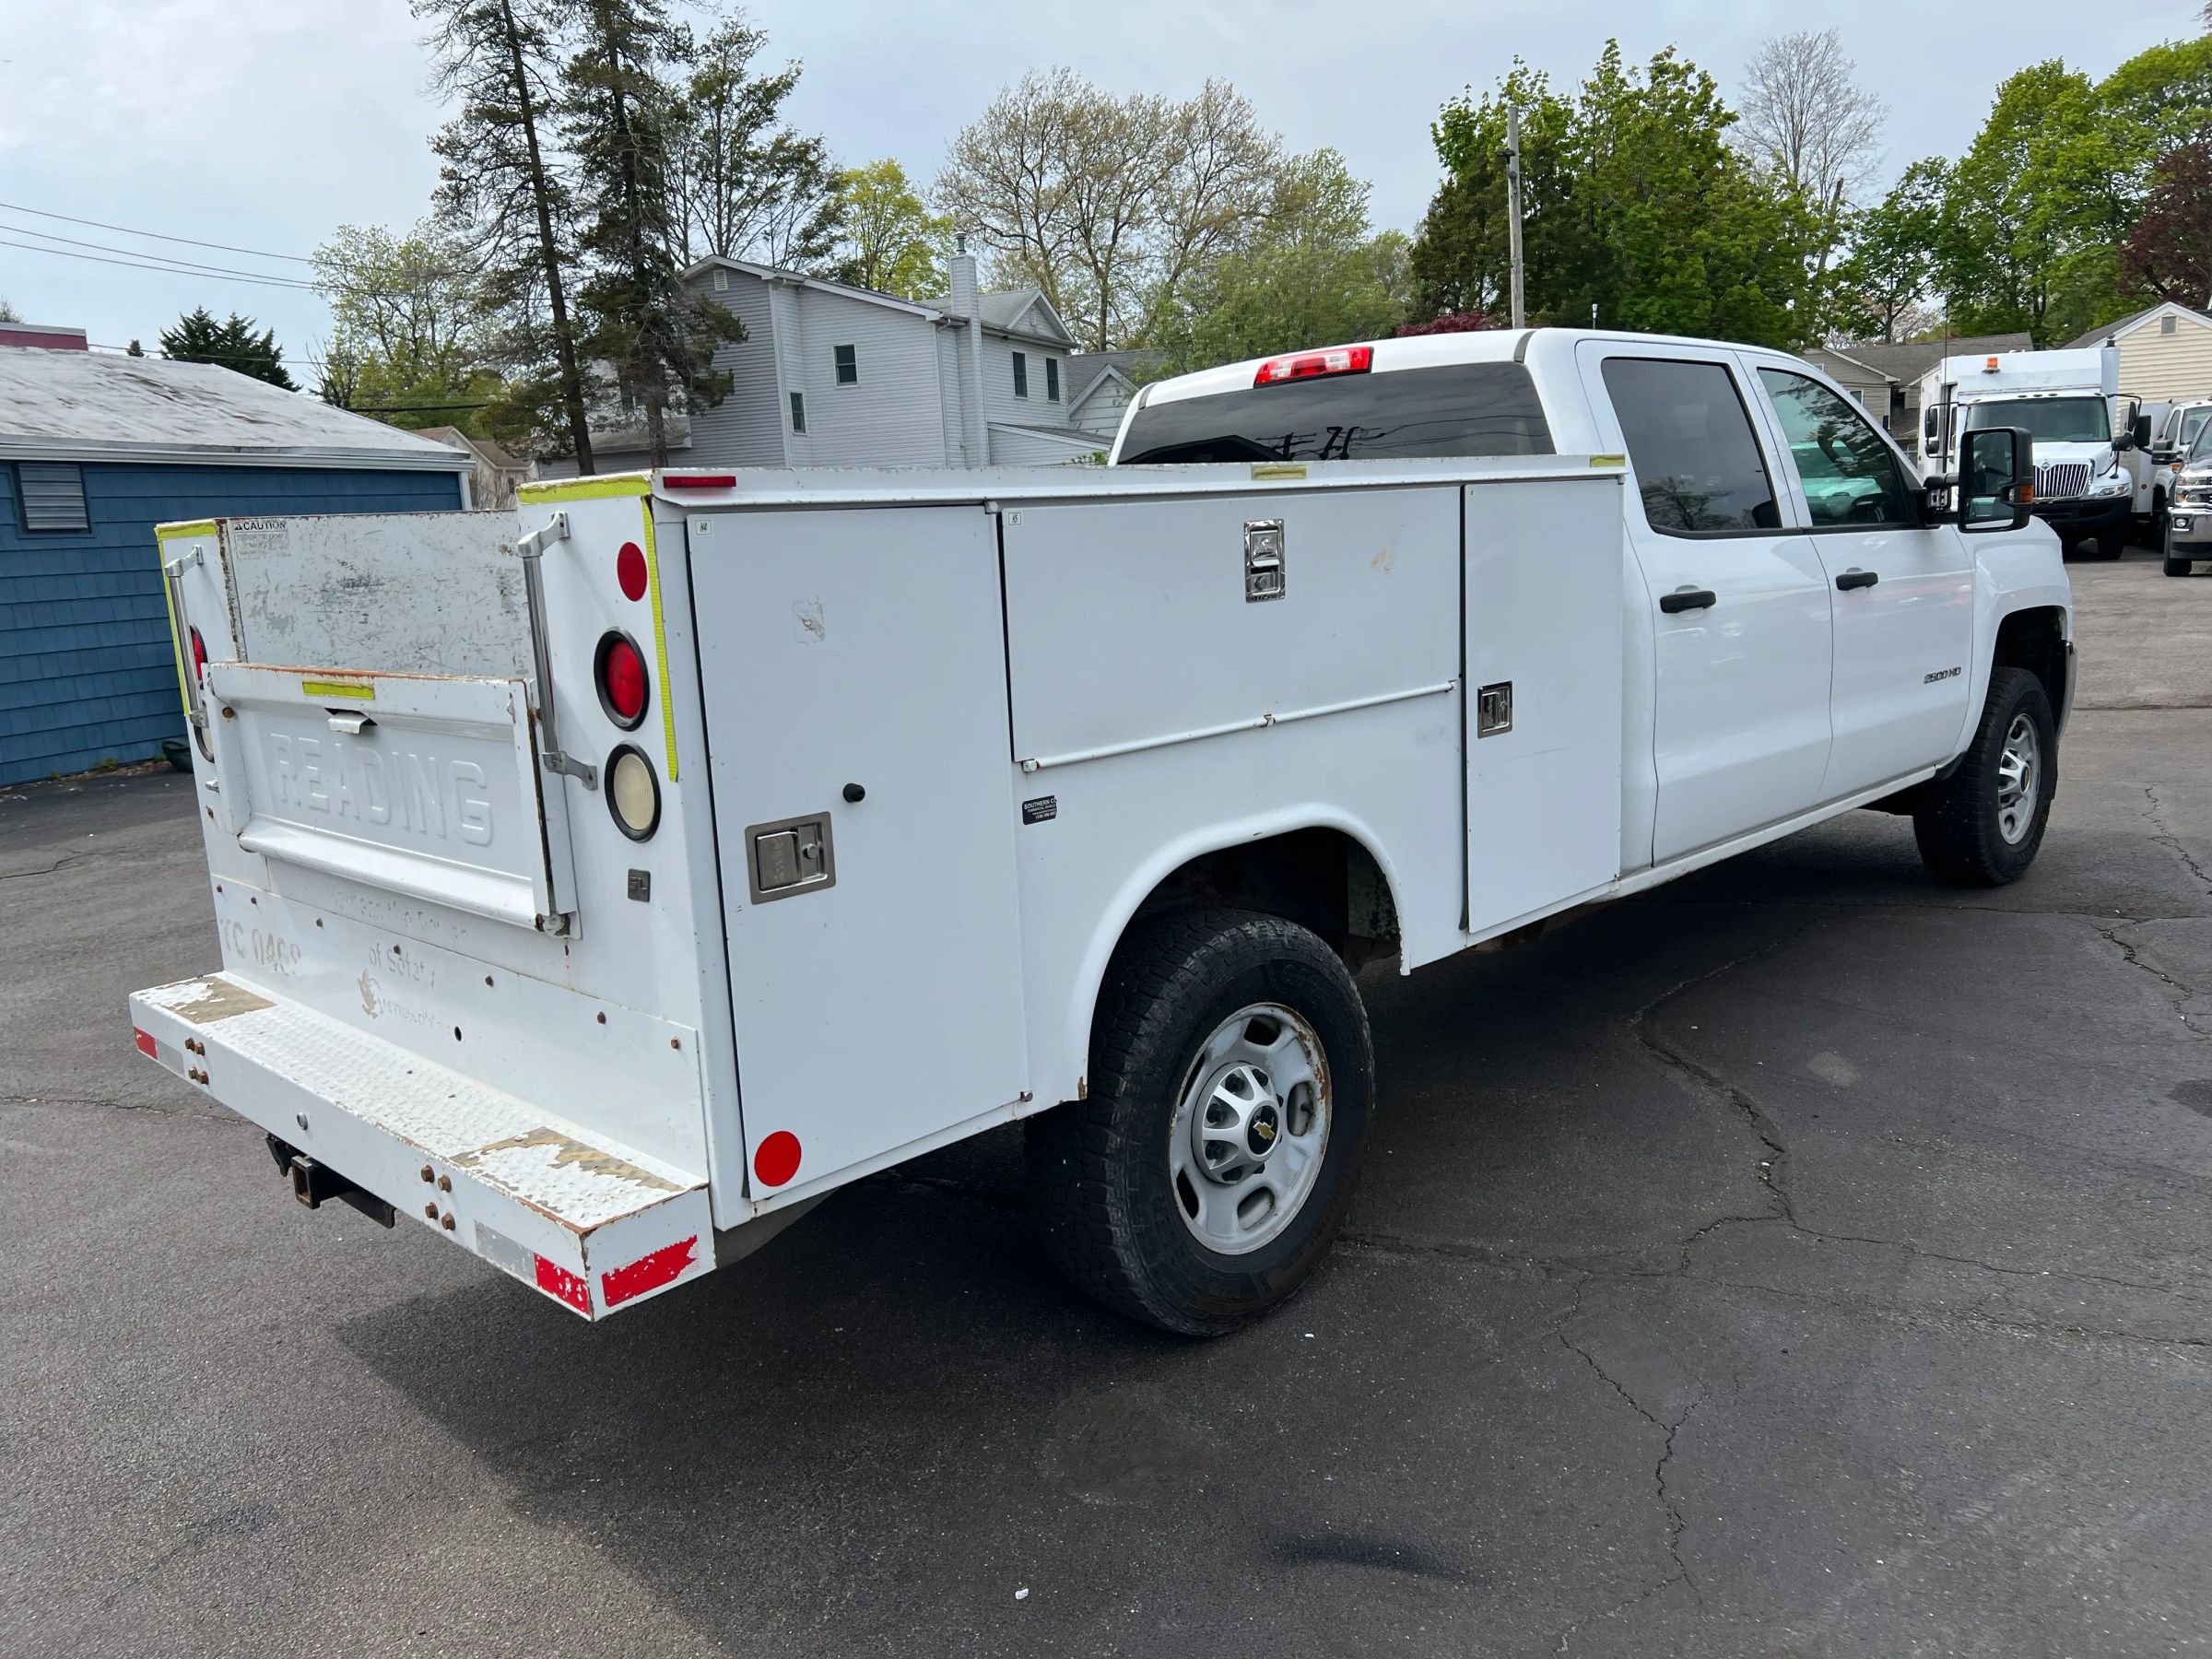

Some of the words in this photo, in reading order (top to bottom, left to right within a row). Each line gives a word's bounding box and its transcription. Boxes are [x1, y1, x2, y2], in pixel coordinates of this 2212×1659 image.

[242, 520, 287, 531] CAUTION
[1947, 666, 1961, 677] HD
[270, 733, 495, 849] READING
[1024, 799, 1051, 809] SOUTHERN
